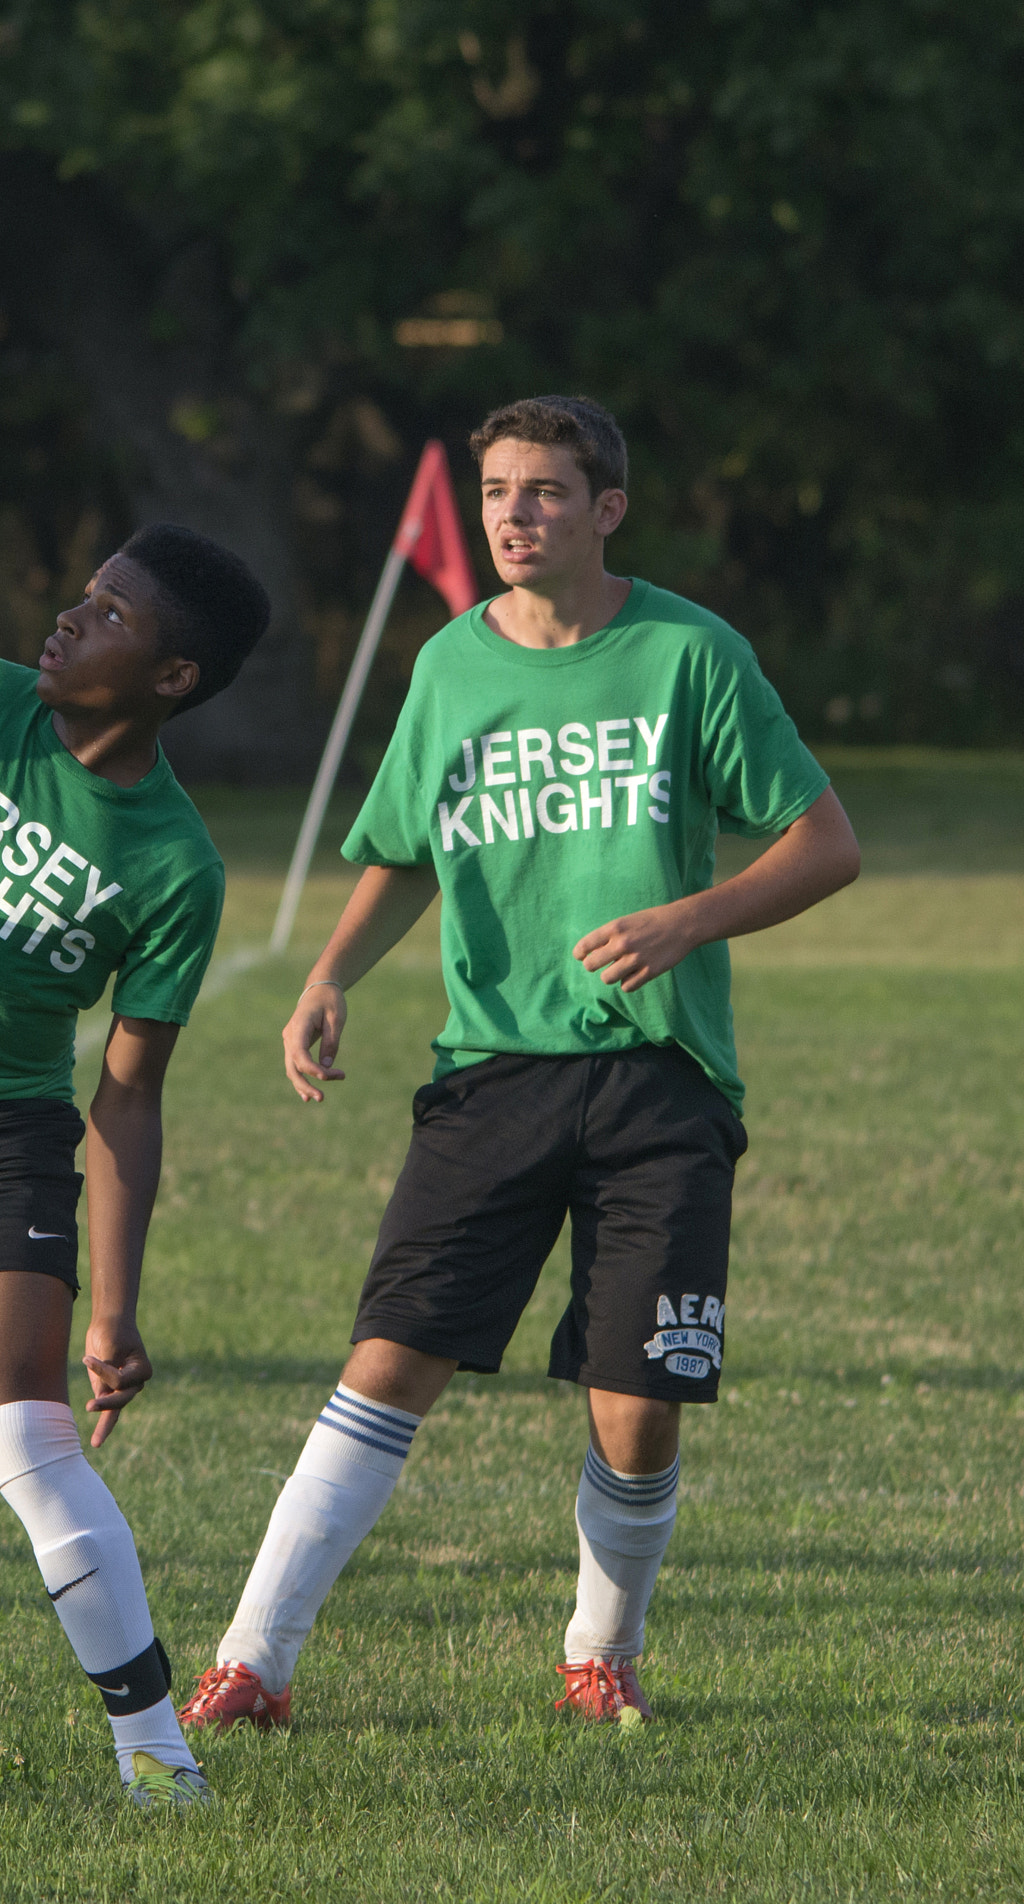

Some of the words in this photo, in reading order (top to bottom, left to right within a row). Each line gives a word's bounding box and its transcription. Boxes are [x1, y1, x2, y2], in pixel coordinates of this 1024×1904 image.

[448, 713, 669, 792] JERSEY
[438, 770, 671, 852] KNIGHTS
[661, 1331, 688, 1347] NEW
[695, 1332, 718, 1353] YORK
[676, 1356, 704, 1374] 1987
